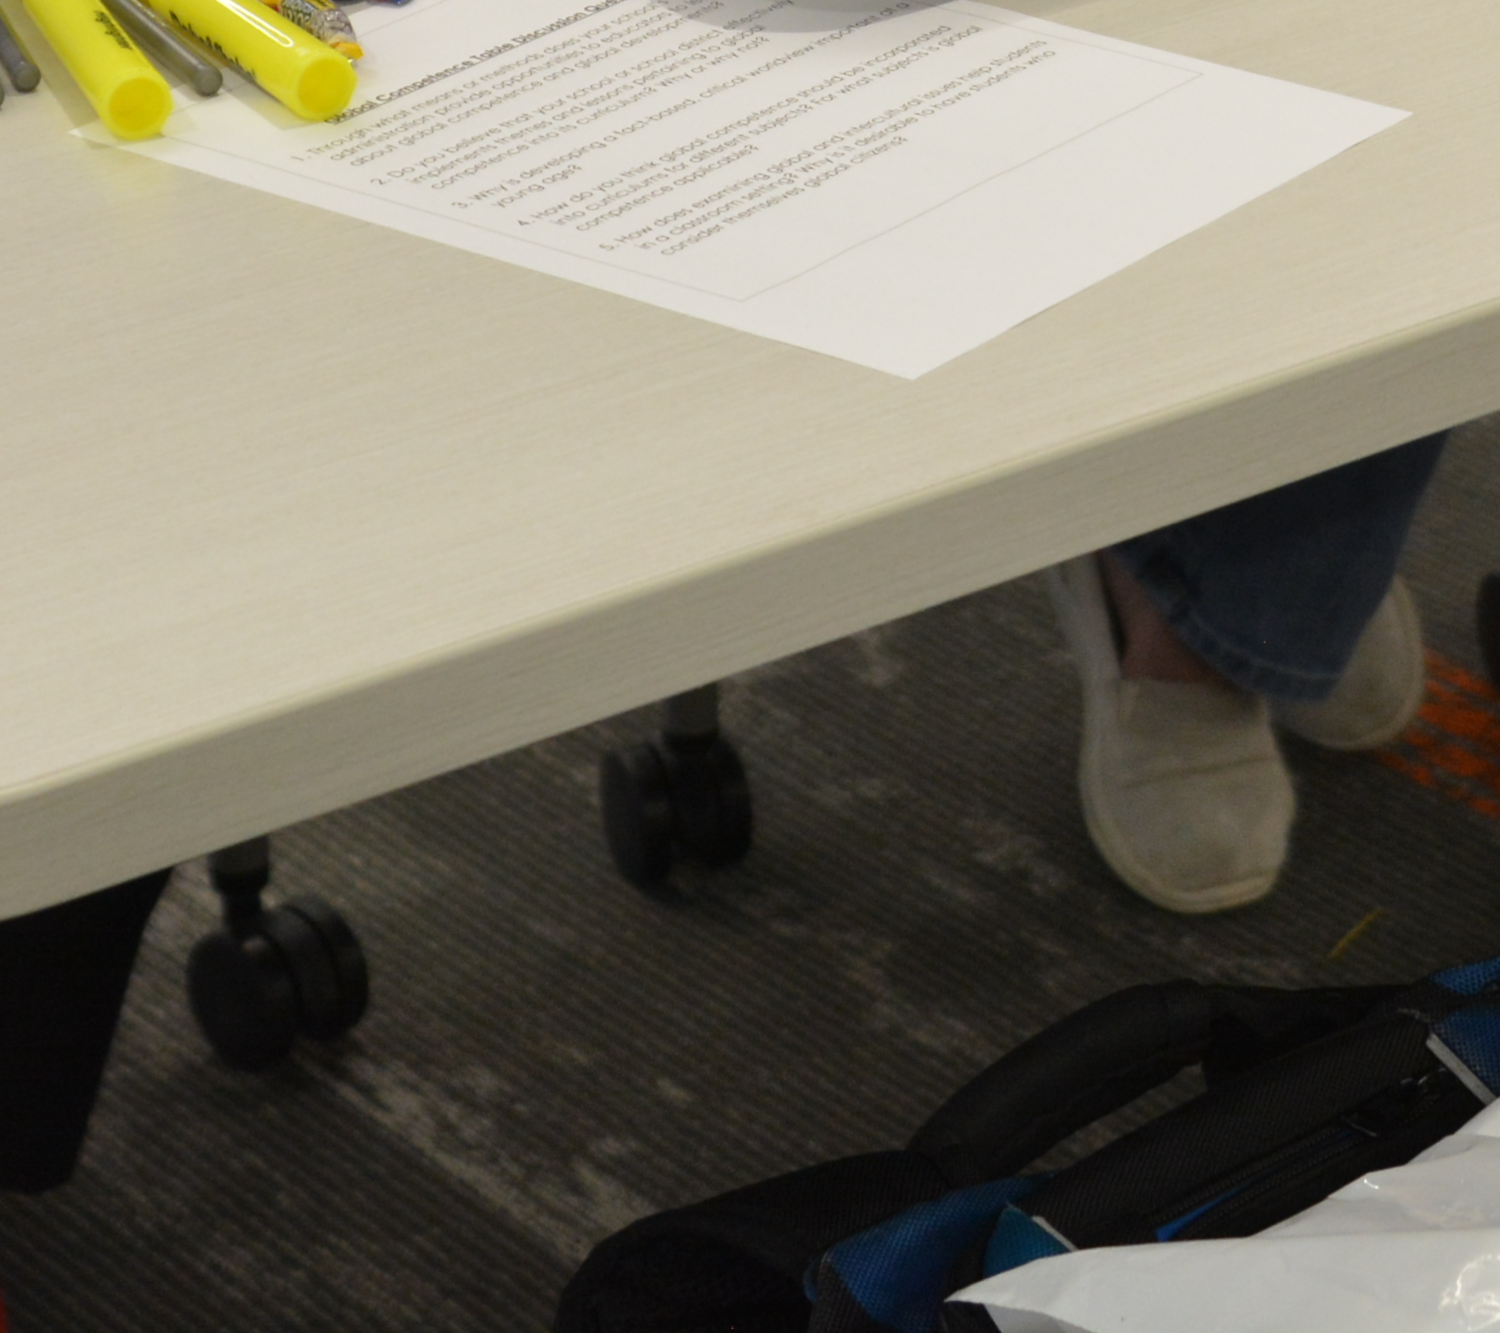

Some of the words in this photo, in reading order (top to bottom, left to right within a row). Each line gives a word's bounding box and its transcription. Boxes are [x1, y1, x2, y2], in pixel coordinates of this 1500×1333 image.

[306, 127, 372, 154] Through
[370, 109, 412, 128] what
[411, 88, 464, 111] means
[462, 80, 479, 88] or
[479, 53, 545, 81] methods
[543, 37, 581, 54] does
[578, 23, 612, 39] your
[322, 100, 382, 124] Global
[375, 60, 479, 103] Competence
[469, 43, 519, 62] Table
[510, 12, 592, 45] Discussion
[330, 114, 435, 161] administration
[434, 89, 492, 116] provide
[491, 49, 584, 89] opportunities
[580, 42, 601, 50] to
[600, 11, 672, 43] educators
[668, 4, 688, 12] to
[350, 144, 398, 166] about
[398, 122, 448, 146] global
[447, 80, 543, 123] competence
[543, 66, 575, 81] and
[574, 46, 621, 68] global
[620, 0, 725, 48] developments?
[386, 166, 415, 178] Do
[414, 152, 446, 168] you
[442, 127, 502, 153] believe
[498, 112, 534, 128] that
[533, 98, 566, 115] your
[565, 76, 616, 100] school
[614, 69, 631, 78] or
[630, 48, 679, 71] school
[677, 29, 724, 50] district
[405, 144, 498, 184] implements
[493, 120, 553, 144] themes
[551, 105, 584, 121] and
[579, 84, 634, 107] lessons
[632, 52, 707, 86] pertaining
[700, 45, 721, 53] to
[720, 24, 766, 46] global
[431, 144, 530, 189] competence
[524, 131, 559, 145] into
[554, 124, 577, 132] its
[576, 86, 658, 124] curriculum?
[655, 72, 692, 87] Why
[690, 65, 707, 73] or
[706, 51, 739, 65] why
[736, 36, 770, 52] not?
[469, 183, 508, 200] Why
[519, 141, 607, 179] developing
[699, 75, 748, 98] critical
[746, 44, 814, 76] worldview
[814, 15, 881, 46] important
[879, 6, 897, 16] at
[530, 201, 569, 219] How
[569, 191, 594, 202] do
[592, 177, 623, 192] you
[619, 160, 661, 178] think
[658, 137, 707, 162] global
[706, 97, 799, 139] competence
[796, 75, 845, 97] should
[839, 66, 865, 76] be
[864, 24, 952, 66] incorporated
[549, 210, 586, 225] into
[585, 172, 669, 211] curriculums
[663, 161, 689, 173] for
[689, 133, 750, 163] different
[748, 103, 814, 135] subjects?
[810, 93, 837, 105] For
[835, 76, 874, 94] what
[871, 51, 929, 77] subjects
[938, 25, 982, 47] global
[614, 225, 653, 243] How
[653, 208, 693, 226] does
[691, 172, 771, 208] examining
[766, 149, 815, 174] global
[813, 134, 845, 151] and
[842, 97, 924, 136] intercultural
[917, 80, 962, 99] issues
[956, 66, 992, 81] help
[989, 40, 1047, 66] students
[492, 183, 545, 208] young
[541, 164, 582, 184] age?
[576, 185, 674, 231] competence
[673, 144, 759, 185] applicable?
[634, 241, 657, 249] in
[655, 234, 671, 242] a
[669, 199, 744, 235] classroom
[740, 172, 799, 200] setting?
[795, 157, 834, 173] Why
[854, 116, 919, 146] desirable
[914, 108, 935, 117] to
[930, 91, 972, 109] have
[968, 64, 1027, 92] students
[1023, 50, 1056, 65] who
[660, 223, 724, 255] consider
[721, 186, 806, 224] themselves
[803, 162, 852, 188] global
[850, 136, 908, 164] citizens?
